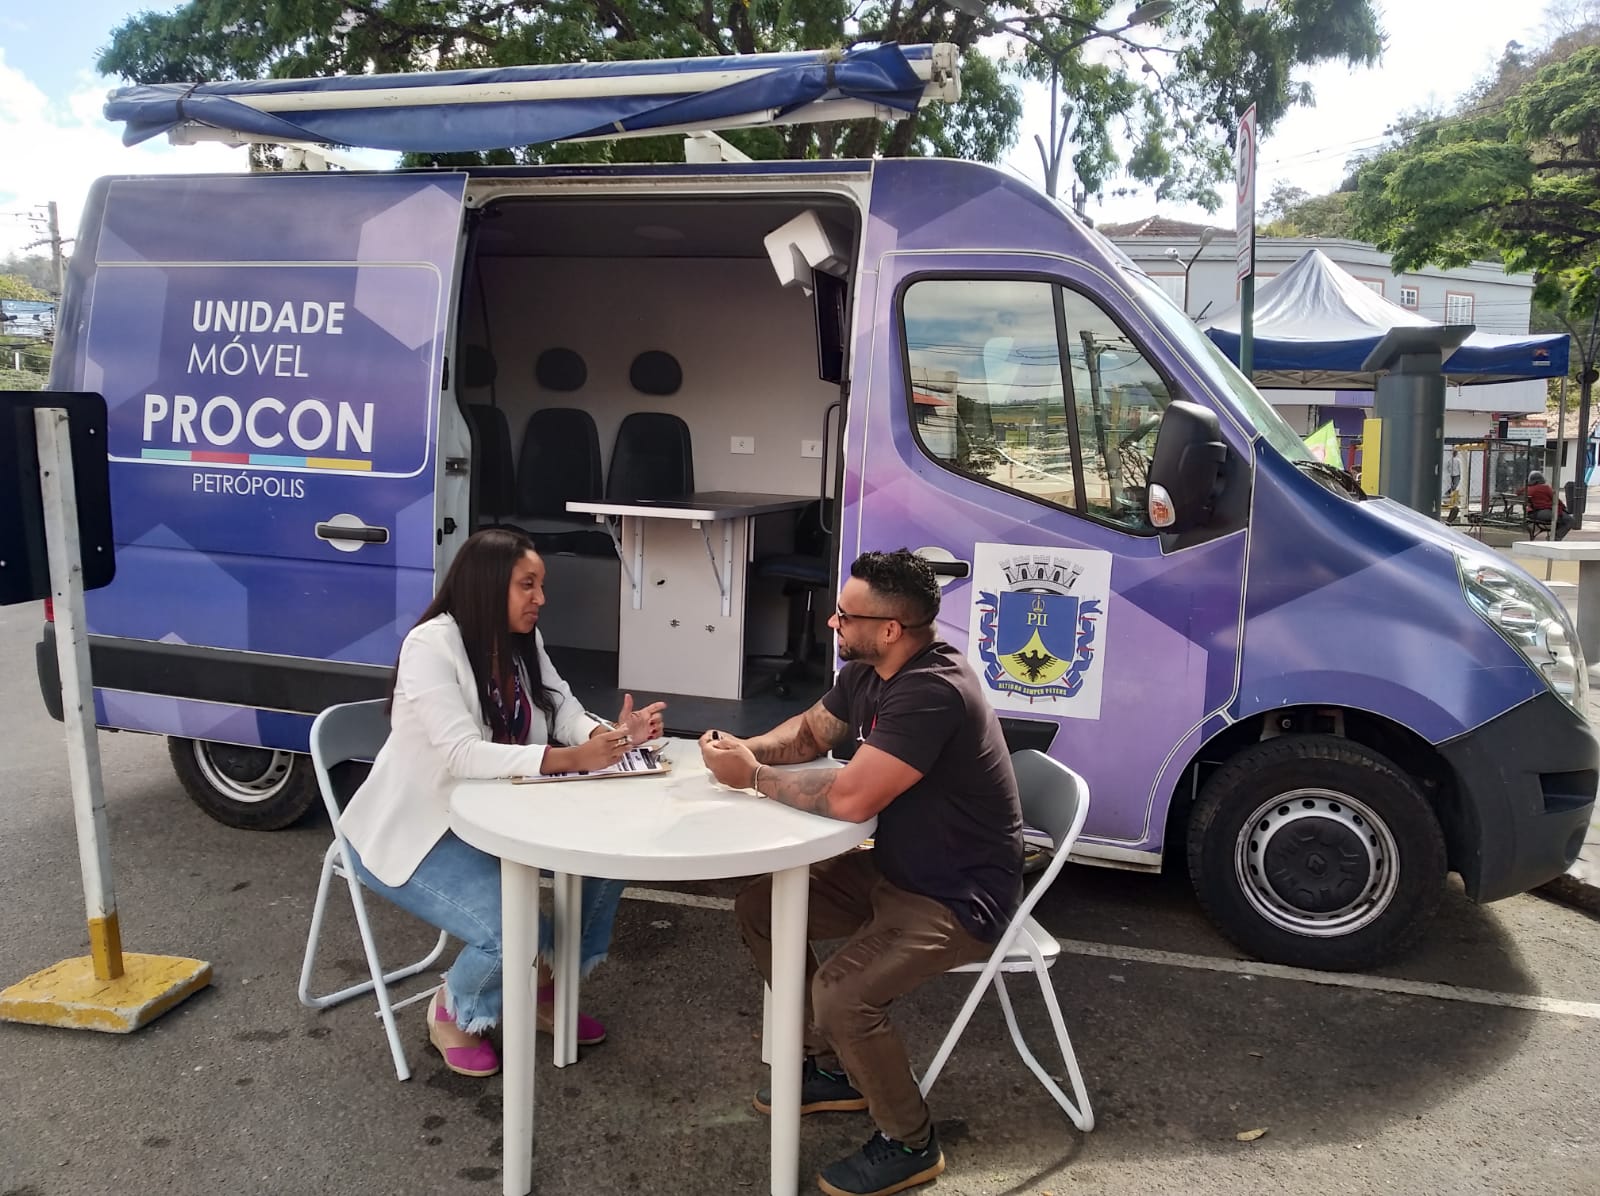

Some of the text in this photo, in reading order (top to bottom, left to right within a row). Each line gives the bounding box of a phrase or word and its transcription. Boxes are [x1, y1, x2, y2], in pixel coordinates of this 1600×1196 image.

[192, 300, 345, 335] UNIDADE
[187, 335, 309, 378] MÓVEL
[142, 394, 374, 453] PROCON
[192, 471, 305, 498] PETRÓPOLIS
